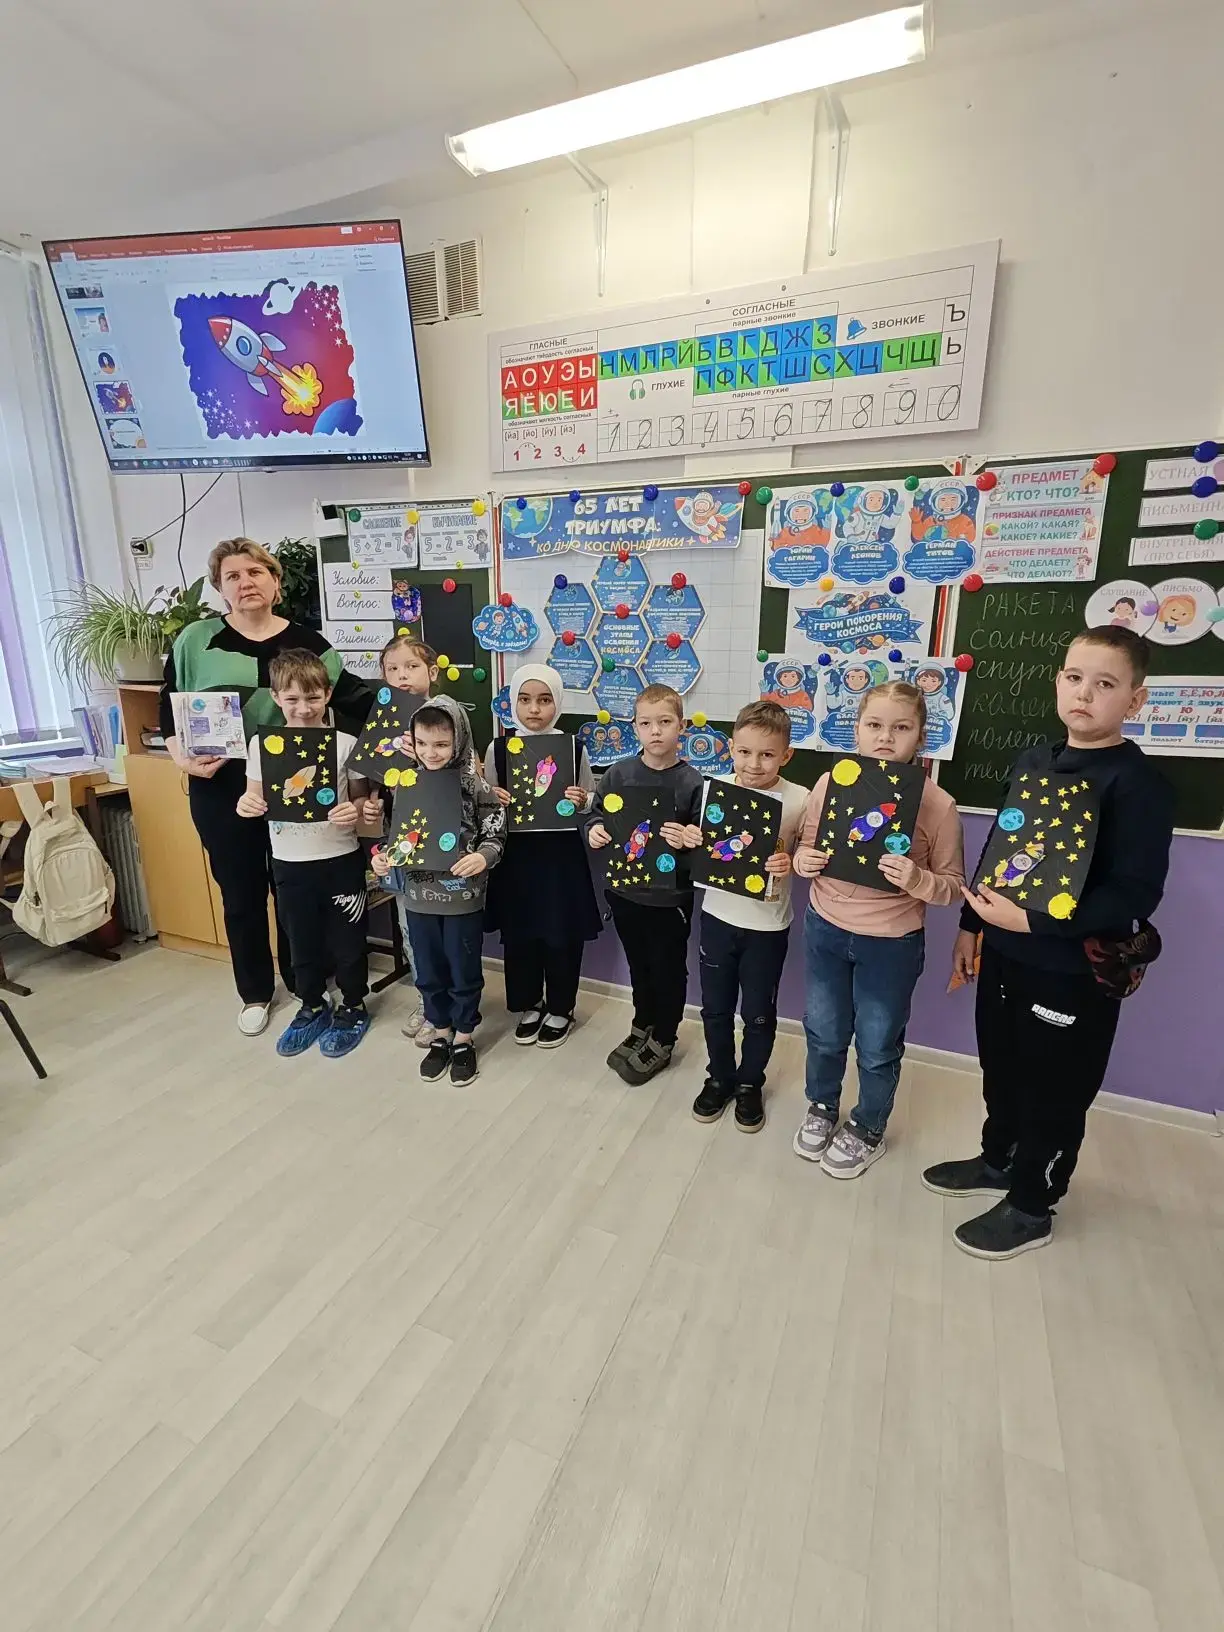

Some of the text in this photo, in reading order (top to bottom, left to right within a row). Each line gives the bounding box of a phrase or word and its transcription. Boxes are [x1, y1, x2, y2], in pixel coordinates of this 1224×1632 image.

[732, 299, 796, 317] СОГЛАСНЫЕ
[732, 311, 797, 328] парные звонкие
[872, 314, 926, 330] ЗВОНКИЕ
[529, 338, 568, 351] ГЛАСНЫЕ
[651, 379, 685, 391] ГЛУХИЕ
[732, 386, 790, 399] парные глухие
[513, 443, 586, 461] 1 2 3 4
[1012, 469, 1080, 485] ПРЕДМЕТ
[1148, 466, 1209, 481] УСТНАЯ
[1007, 487, 1080, 502] КТО? ЧТО?
[574, 495, 644, 515] 65 ЛЕТ
[992, 507, 1092, 520] ПРИЗНАК ПРЕДМЕТА
[565, 517, 662, 536] ТРИУМФА:
[1001, 519, 1080, 530] КАКОЙ? КАКАЯ?
[1000, 531, 1078, 542] КАКОЕ? КАКИЕ?
[584, 536, 685, 553] КОСМОНАВТИКИ
[985, 547, 1089, 558] ДЕЙСТВИЕ ПРЕДМЕТА
[1009, 559, 1071, 569] ЧТО ДЕЛАЕТ?
[332, 568, 380, 586] Условие:
[1007, 570, 1073, 579] ЧТО ДЕЛАЮТ?
[1100, 588, 1149, 598] СЛУШАНИЕ
[1162, 584, 1204, 594] ПИСЬМО
[336, 593, 381, 615] Вопрос:
[982, 590, 1075, 620] РАКЕТА
[814, 612, 903, 632] ГЕРОИ ПОКОРЕНИЯ
[836, 622, 882, 638] КОСМОСА
